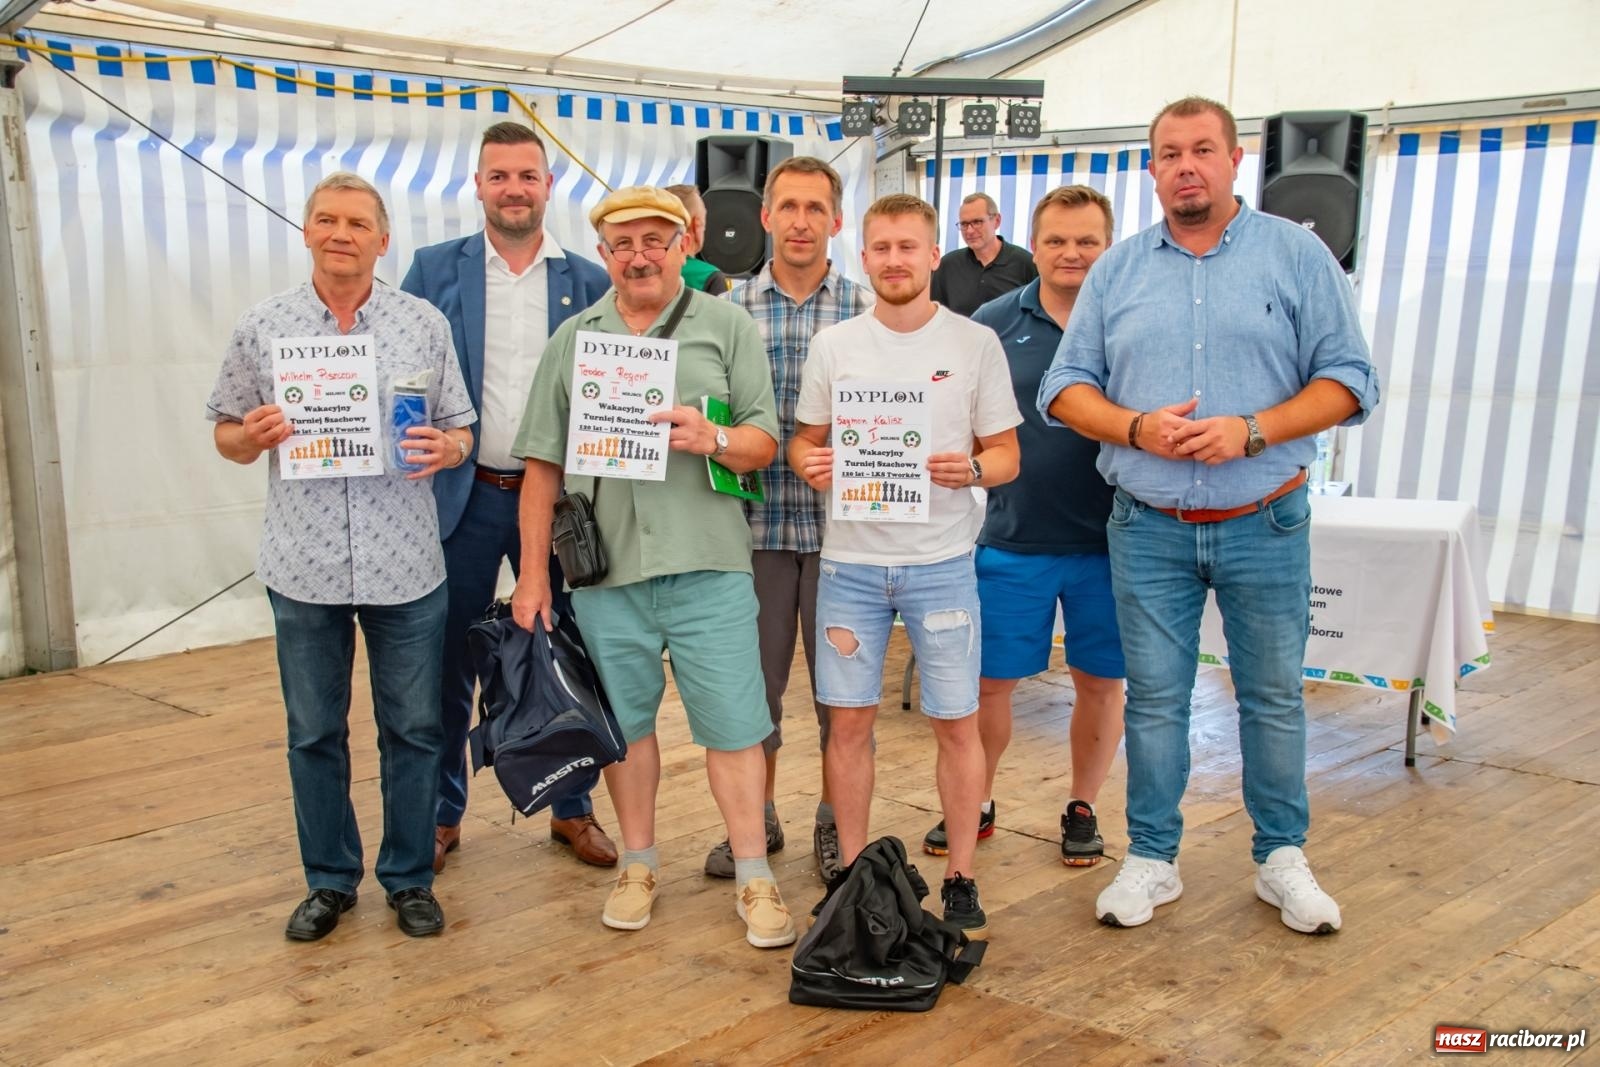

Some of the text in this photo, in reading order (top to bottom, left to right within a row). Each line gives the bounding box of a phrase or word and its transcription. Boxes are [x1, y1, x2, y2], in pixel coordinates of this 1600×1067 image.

[280, 345, 368, 360] DYPLOM
[583, 341, 670, 362] DYPLOM
[839, 390, 925, 403] DYPLOM
[303, 405, 352, 413] Wakacyjny
[598, 402, 646, 414] Wakacyjny
[289, 416, 367, 425] Turniej Szachowy
[583, 412, 658, 427] Turniej Szachowy
[336, 426, 371, 434] Tworków
[626, 428, 661, 437] Tworków
[858, 449, 904, 458] Wakacyjny
[844, 460, 918, 469] Turniej Szachowy
[1311, 585, 1343, 596] towe
